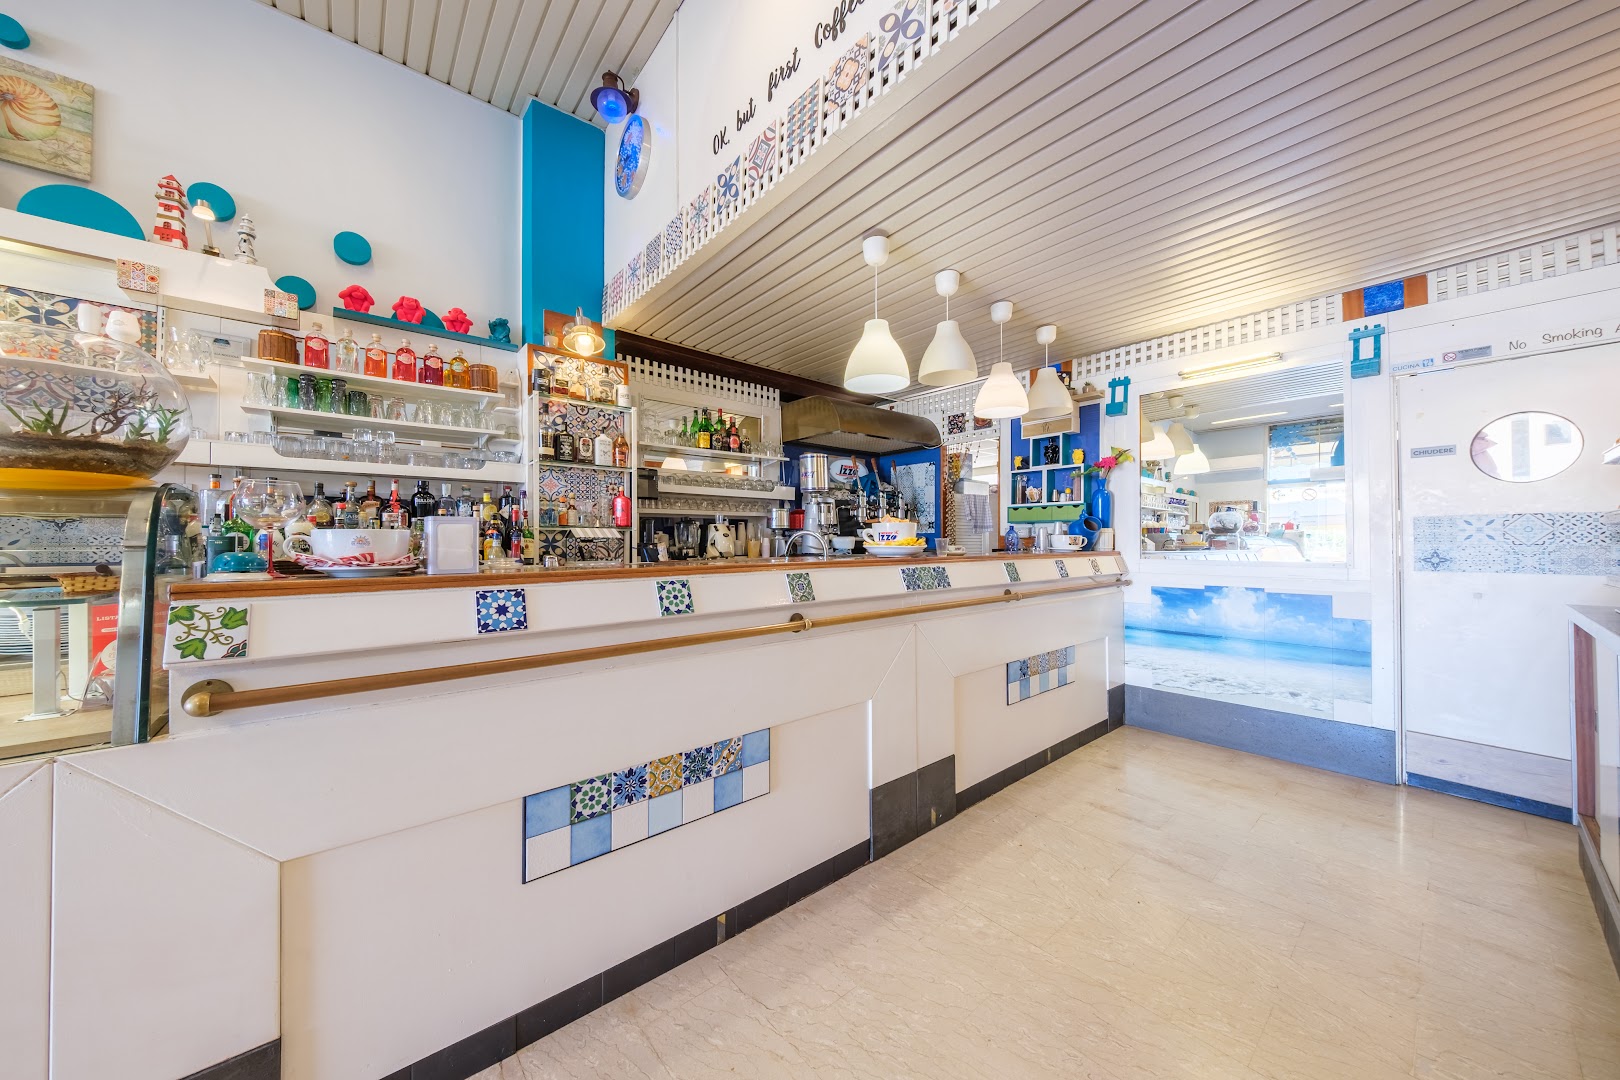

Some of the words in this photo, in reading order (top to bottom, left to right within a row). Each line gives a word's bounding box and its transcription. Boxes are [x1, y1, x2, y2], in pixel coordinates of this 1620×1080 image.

[736, 97, 757, 132] but
[767, 47, 801, 102] first
[814, 0, 865, 48] Coffe
[1508, 340, 1527, 350] No
[1542, 327, 1603, 344] Smoking
[1392, 363, 1420, 372] CUCINA
[1412, 447, 1454, 456] CHIUDERE
